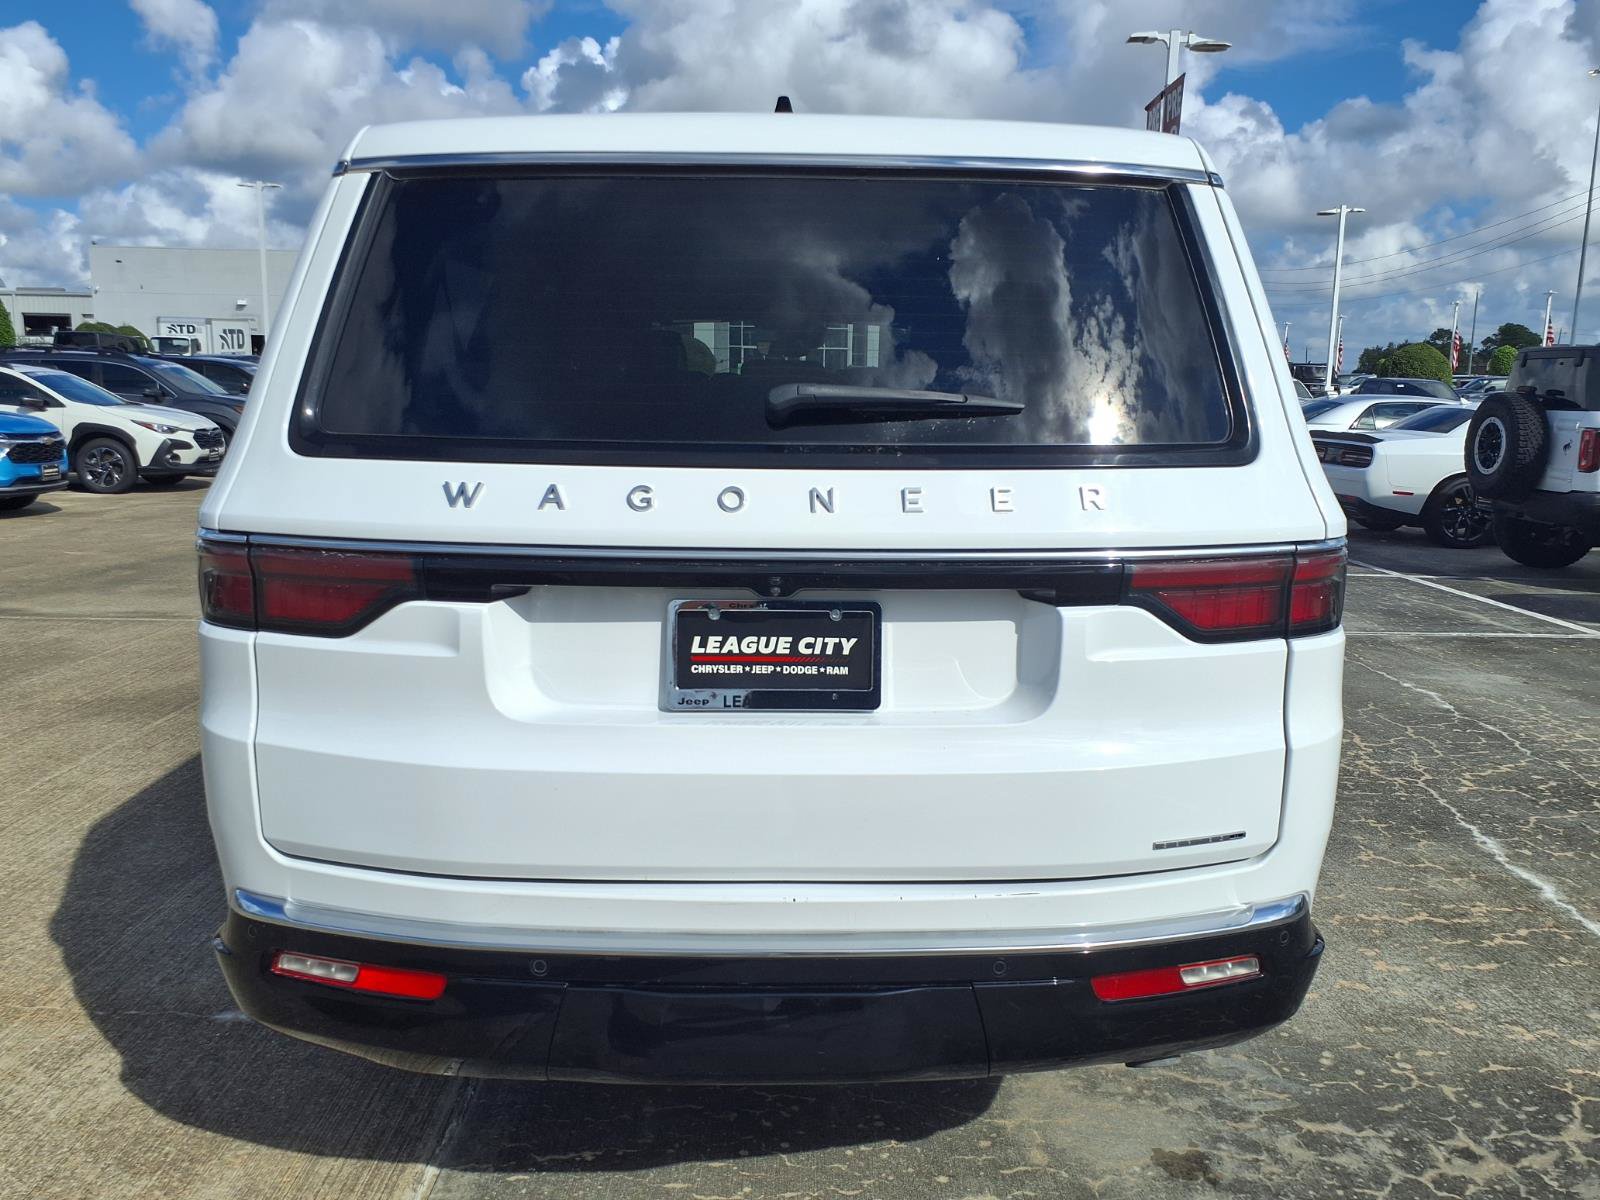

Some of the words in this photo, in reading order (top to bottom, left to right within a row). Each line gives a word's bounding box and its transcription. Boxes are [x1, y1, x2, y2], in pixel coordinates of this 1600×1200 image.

[166, 323, 196, 334] ATD
[219, 328, 245, 350] ATD
[442, 480, 1105, 513] WAGONEER
[690, 635, 793, 655] LEAGUE
[797, 636, 858, 656] CITY
[690, 664, 744, 674] CHRYSLER
[751, 665, 775, 674] JEEP
[782, 665, 818, 675] DODGE
[826, 666, 849, 675] RAM
[677, 696, 710, 706] Jeep
